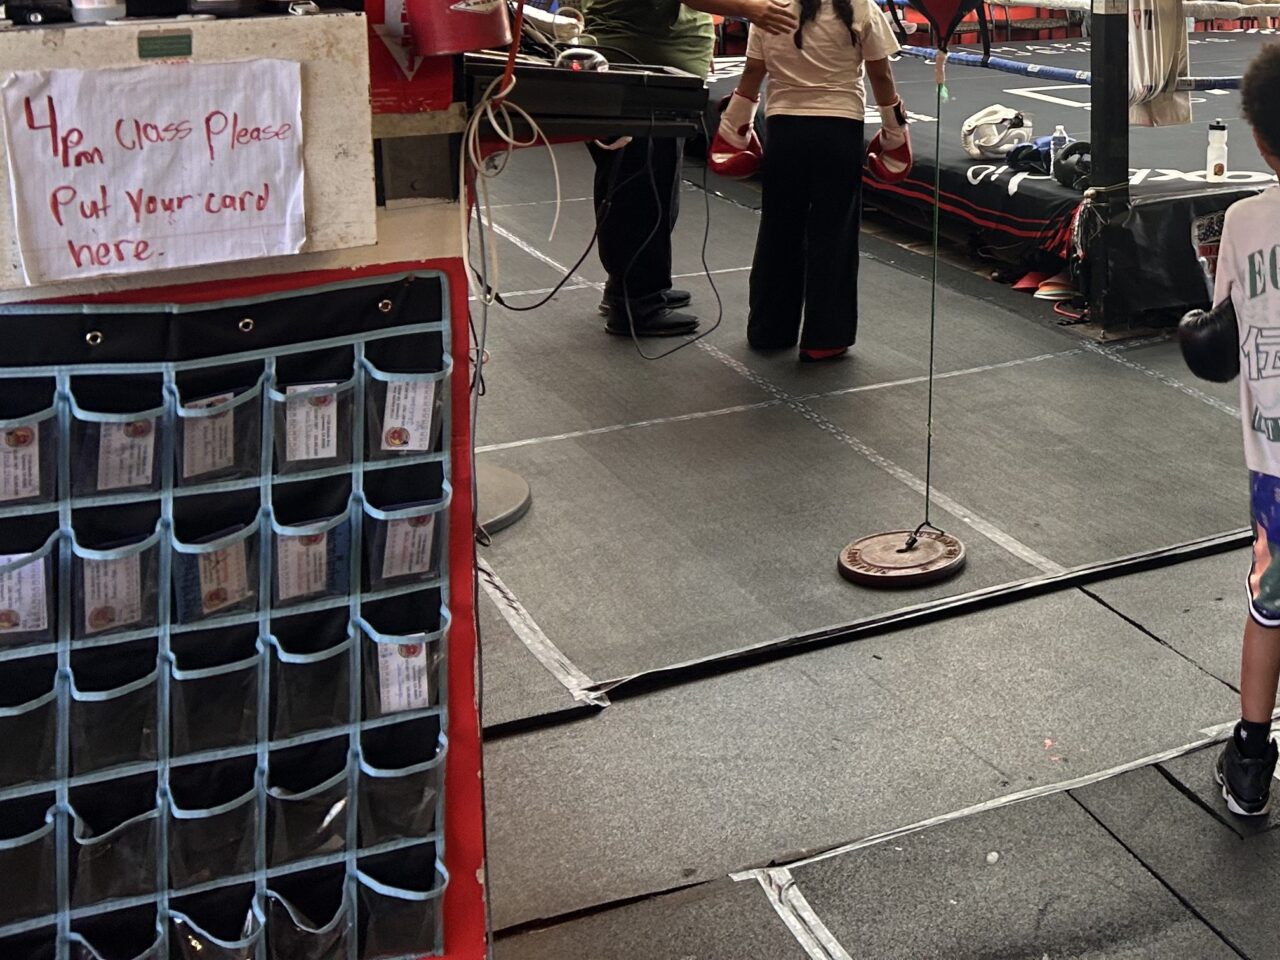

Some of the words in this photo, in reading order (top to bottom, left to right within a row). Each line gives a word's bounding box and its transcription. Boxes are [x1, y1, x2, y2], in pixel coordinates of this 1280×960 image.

[204, 110, 293, 160] Please
[50, 185, 111, 226] Put
[204, 183, 270, 214] card
